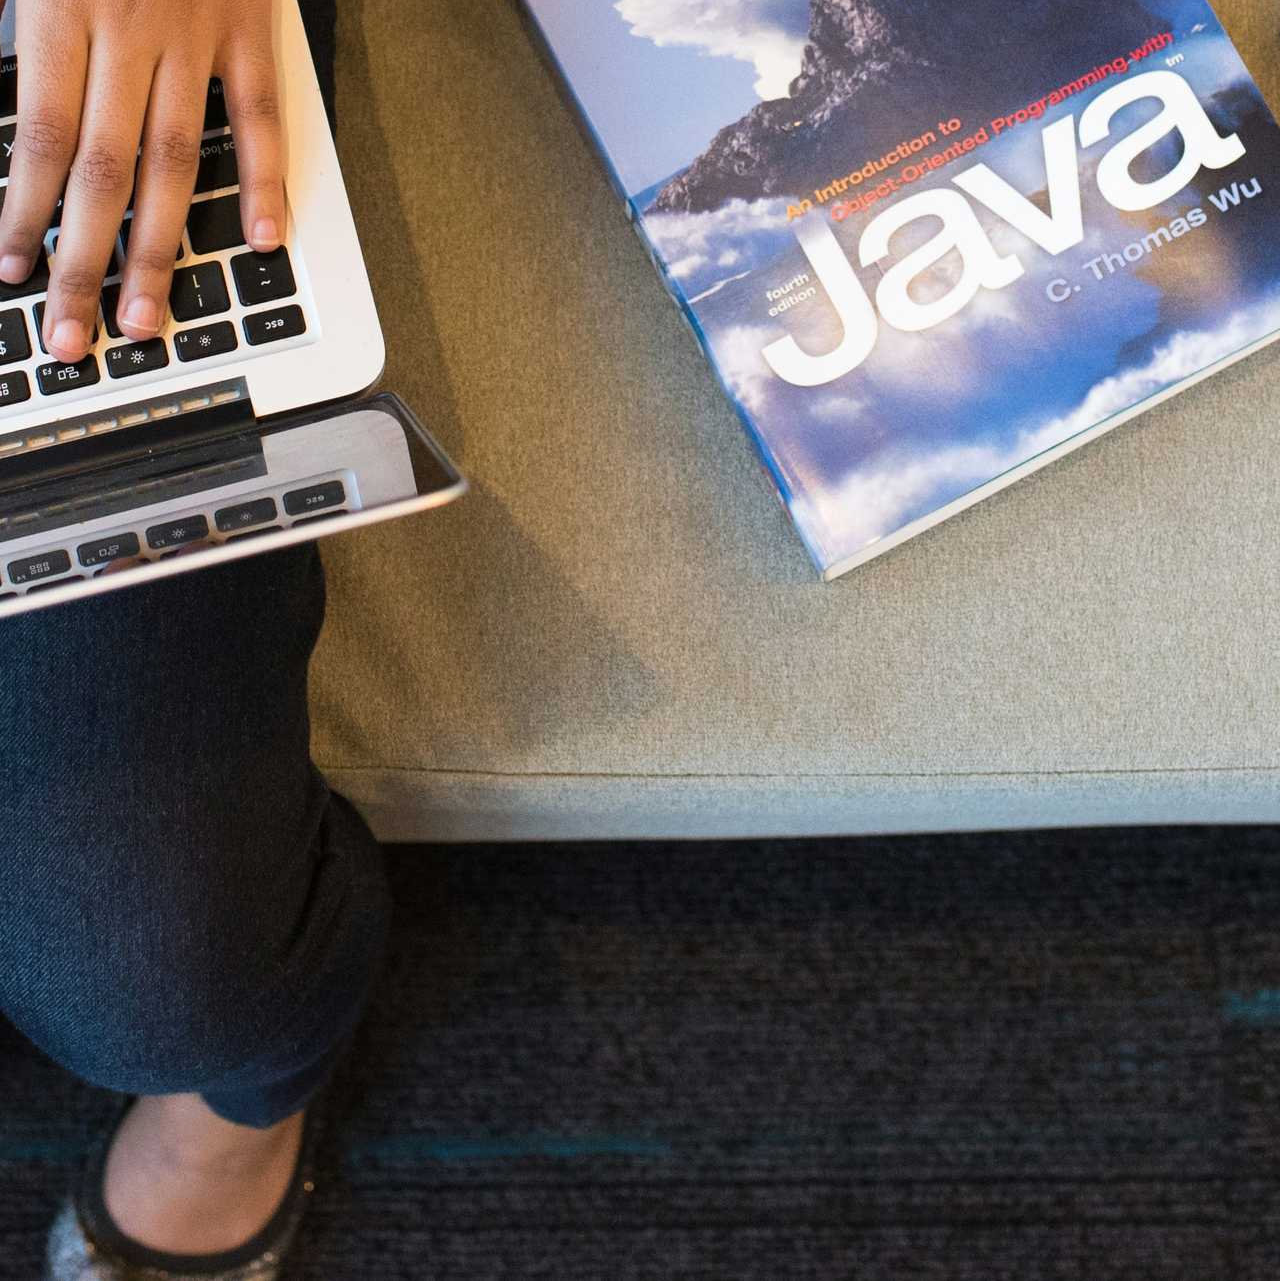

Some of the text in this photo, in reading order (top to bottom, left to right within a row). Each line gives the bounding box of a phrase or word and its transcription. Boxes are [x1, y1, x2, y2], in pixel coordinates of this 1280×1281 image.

[831, 31, 1173, 223] Object-Oriented Programming with
[787, 119, 961, 220] An Introduction to
[761, 71, 1246, 386] Java
[1046, 177, 1262, 302] C. Thomas Wu
[766, 273, 809, 302] fourth
[768, 286, 817, 317] edition
[179, 334, 188, 343] F1
[264, 318, 285, 330] esc
[111, 350, 122, 360] F2
[42, 367, 53, 376] F3
